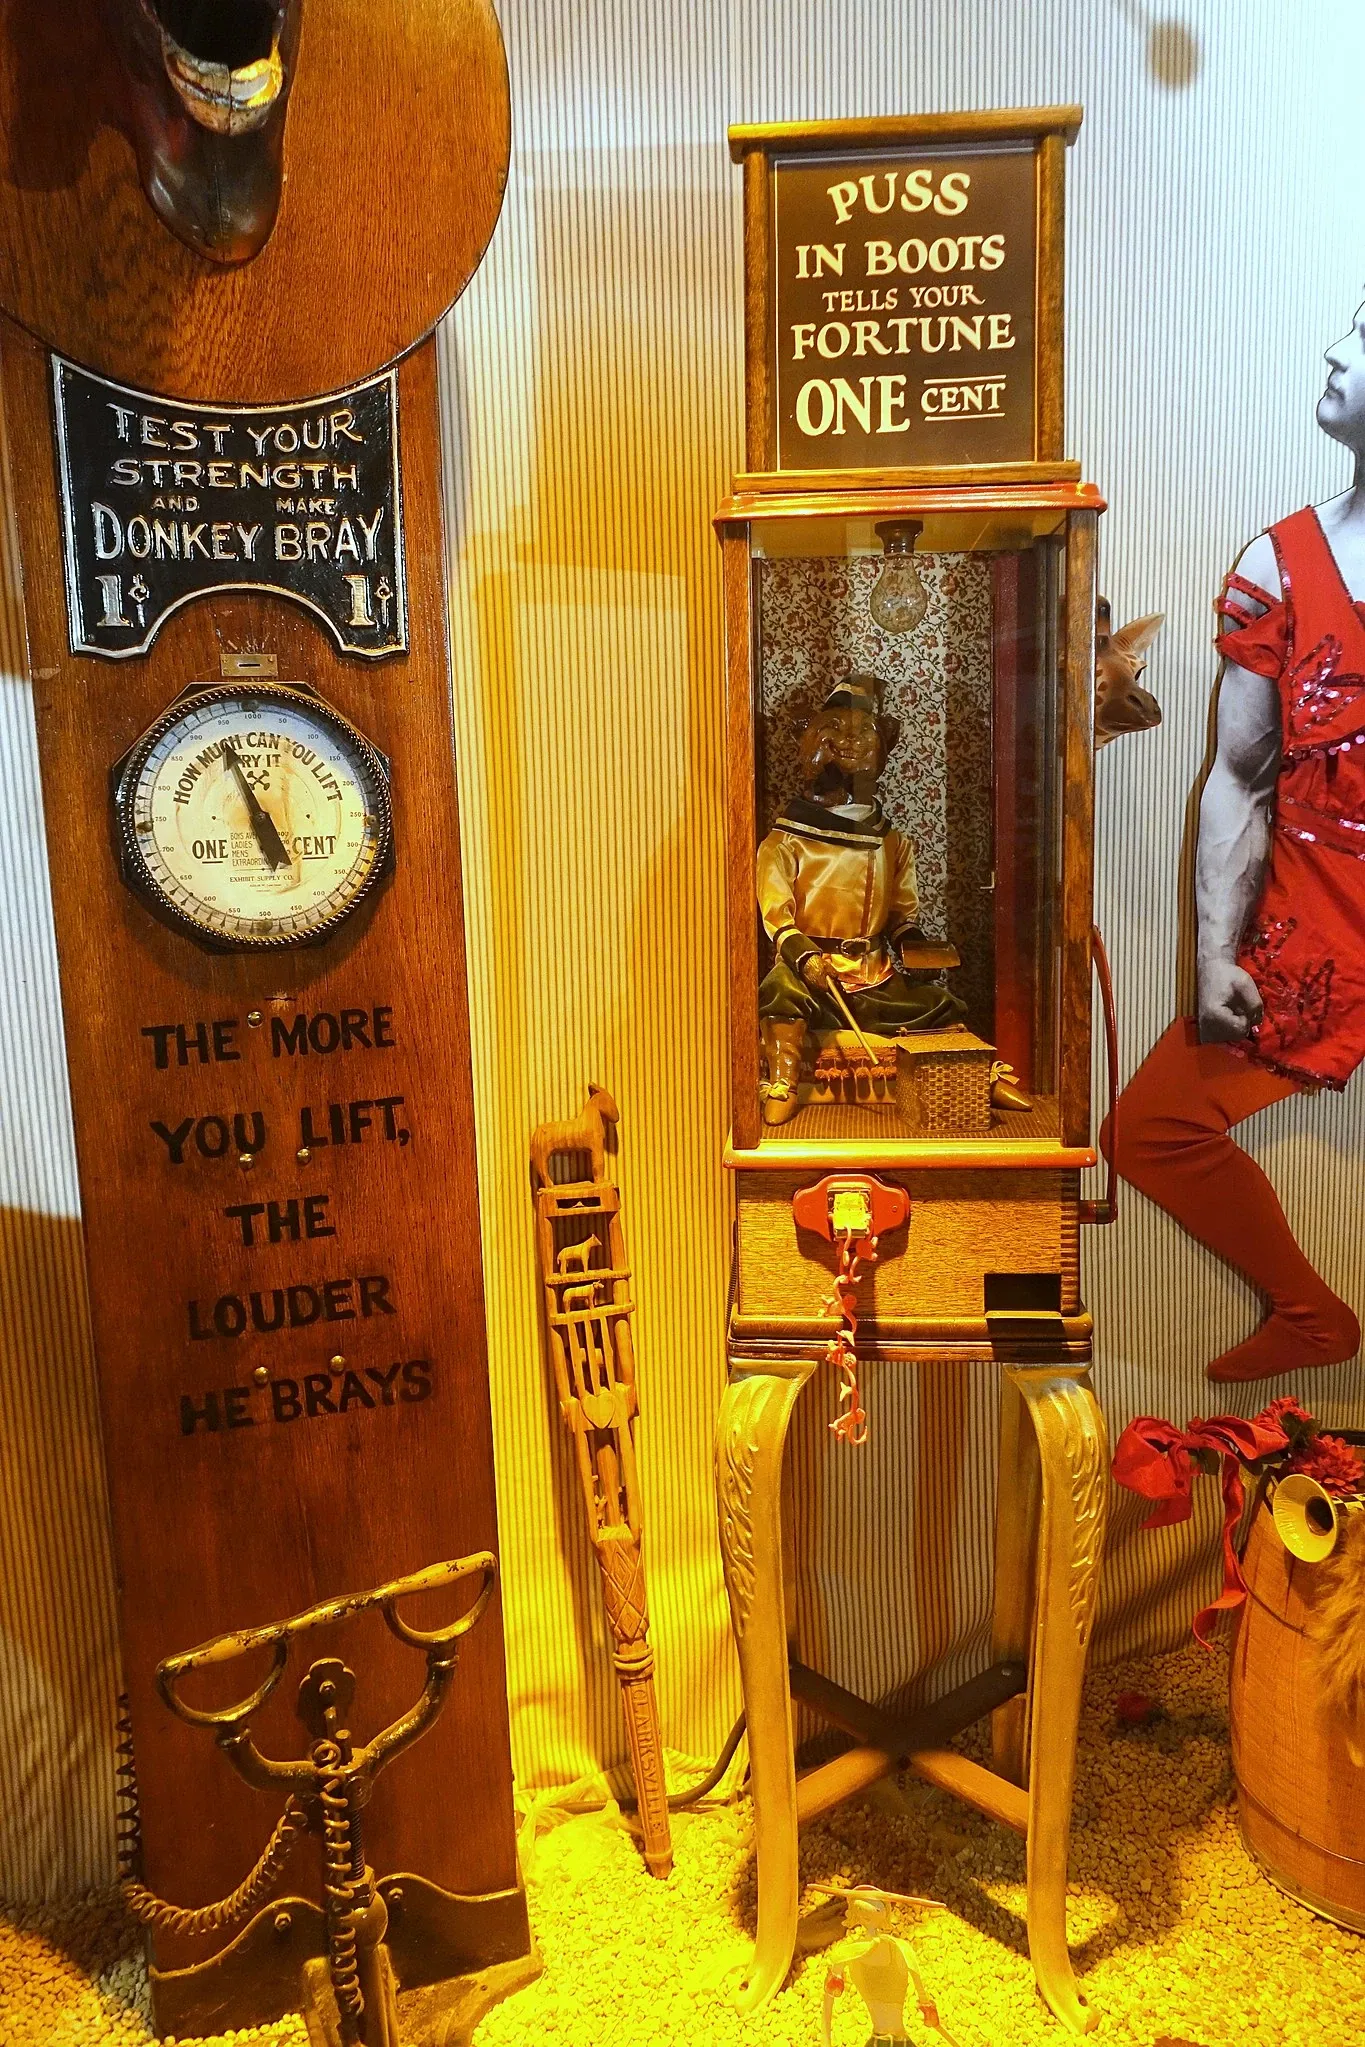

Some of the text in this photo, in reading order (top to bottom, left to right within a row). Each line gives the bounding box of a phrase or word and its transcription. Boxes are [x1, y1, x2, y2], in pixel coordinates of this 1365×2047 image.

[827, 169, 971, 225] PUSS
[795, 234, 1006, 279] IN BOOTS
[822, 284, 986, 313] TELLS YOUR
[790, 313, 1016, 360] FORTUNE
[795, 374, 1006, 436] ONE CENT
[105, 402, 364, 456] TEST YOUR
[110, 458, 360, 492] STRENGTH
[150, 496, 337, 516] AND MAKE
[91, 501, 385, 564] DONKEY BRAY
[217, 718, 230, 726] 950
[278, 717, 288, 725] 50
[307, 733, 319, 741] 100
[173, 731, 343, 805] HOW MUCH CAN YOU LIFT
[239, 753, 282, 768] RY IT
[192, 835, 337, 860] ONE CENT
[231, 841, 253, 850] LADIES
[232, 850, 249, 858] MENS
[141, 1006, 395, 1070] THE MORE
[149, 1096, 411, 1164] YOU LIFT,
[225, 1194, 336, 1247] THE
[188, 1274, 397, 1341] LOUDER
[179, 1358, 434, 1436] HE BRAYS
